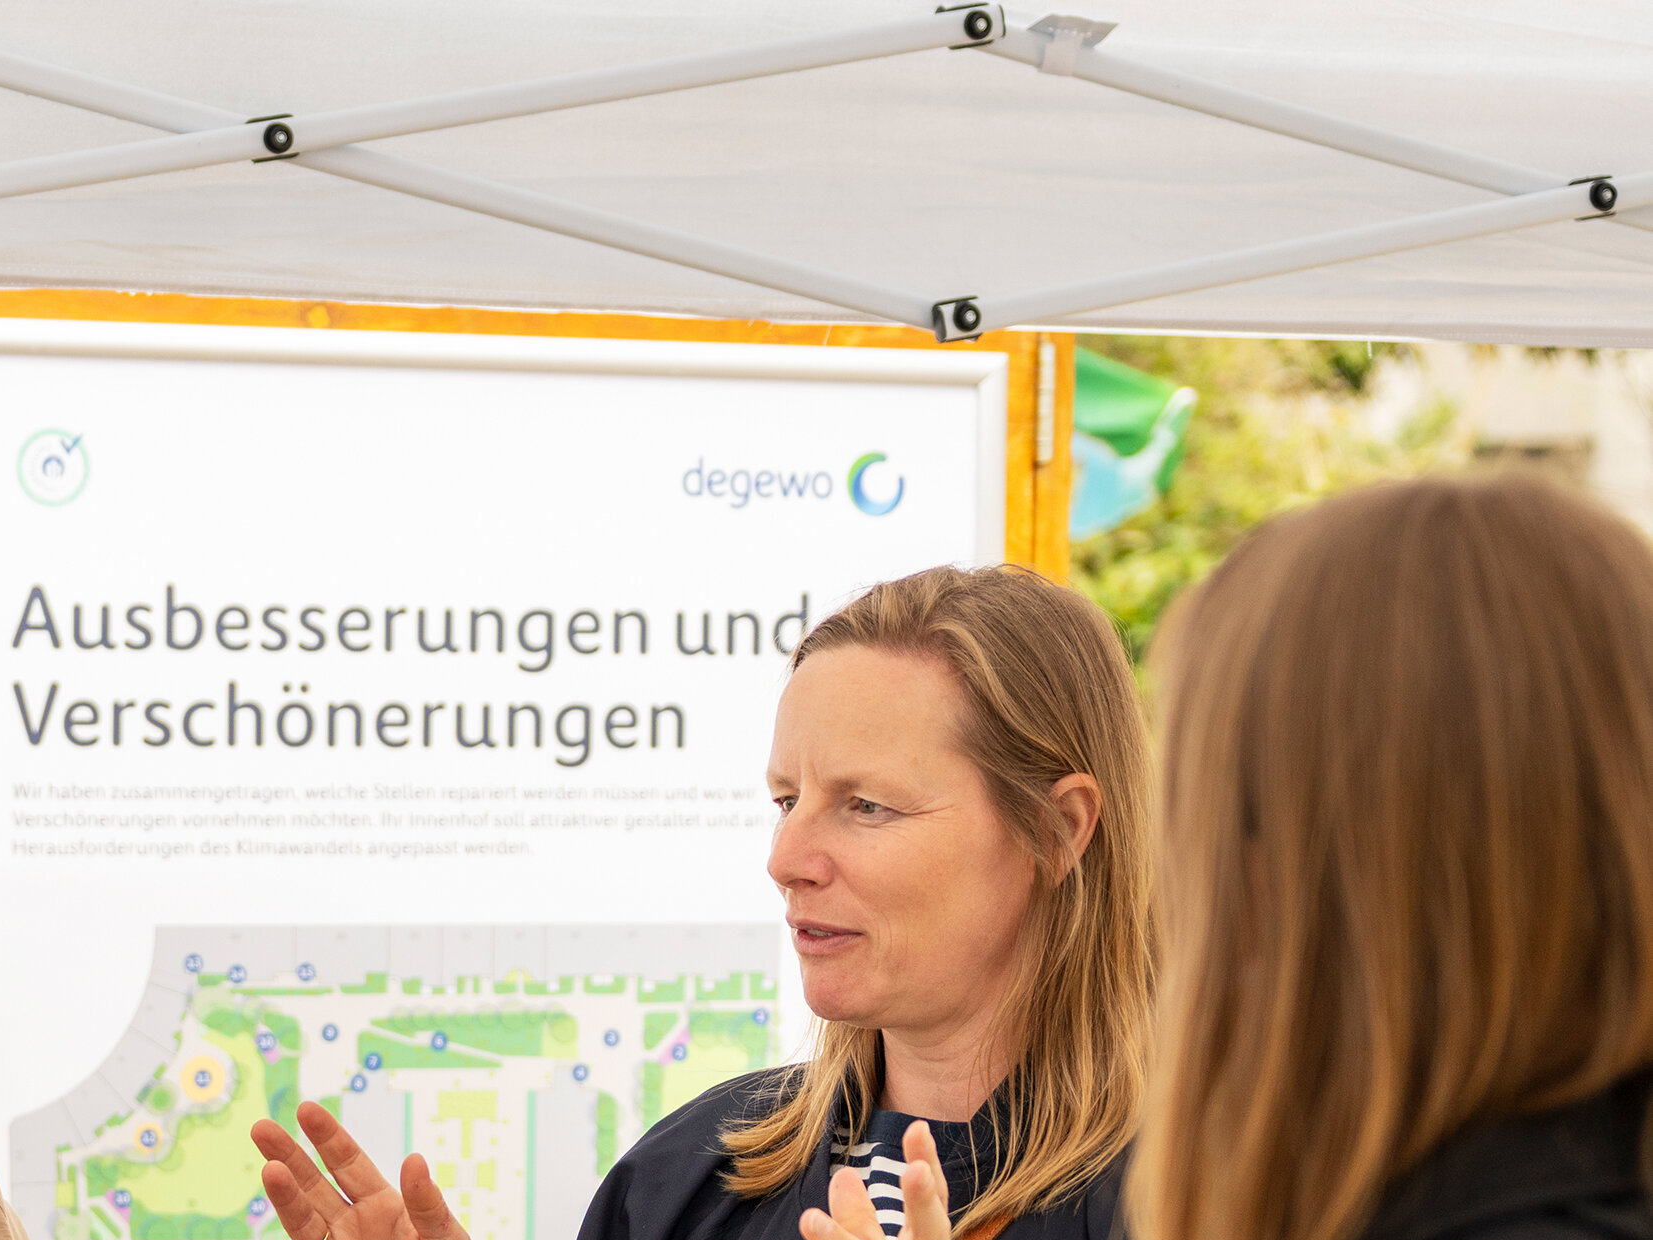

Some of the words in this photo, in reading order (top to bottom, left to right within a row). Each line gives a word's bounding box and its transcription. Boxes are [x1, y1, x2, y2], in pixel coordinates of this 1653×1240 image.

[682, 455, 833, 509] degewo
[12, 584, 649, 673] Ausbesserungen
[677, 592, 808, 657] und
[12, 681, 686, 767] Verschönerungen
[13, 782, 42, 800] Wir
[48, 782, 107, 800] haben
[305, 782, 367, 800] welche
[373, 782, 436, 801] Stellen
[441, 782, 518, 805] repariert
[523, 783, 587, 801] werden
[664, 783, 699, 801] und
[13, 810, 176, 831] Verschönerungen
[182, 811, 285, 829] vornehmen
[707, 811, 742, 828] und
[13, 838, 193, 860] Herausforderungen
[199, 839, 230, 856] des
[235, 838, 361, 856] Klimawandels
